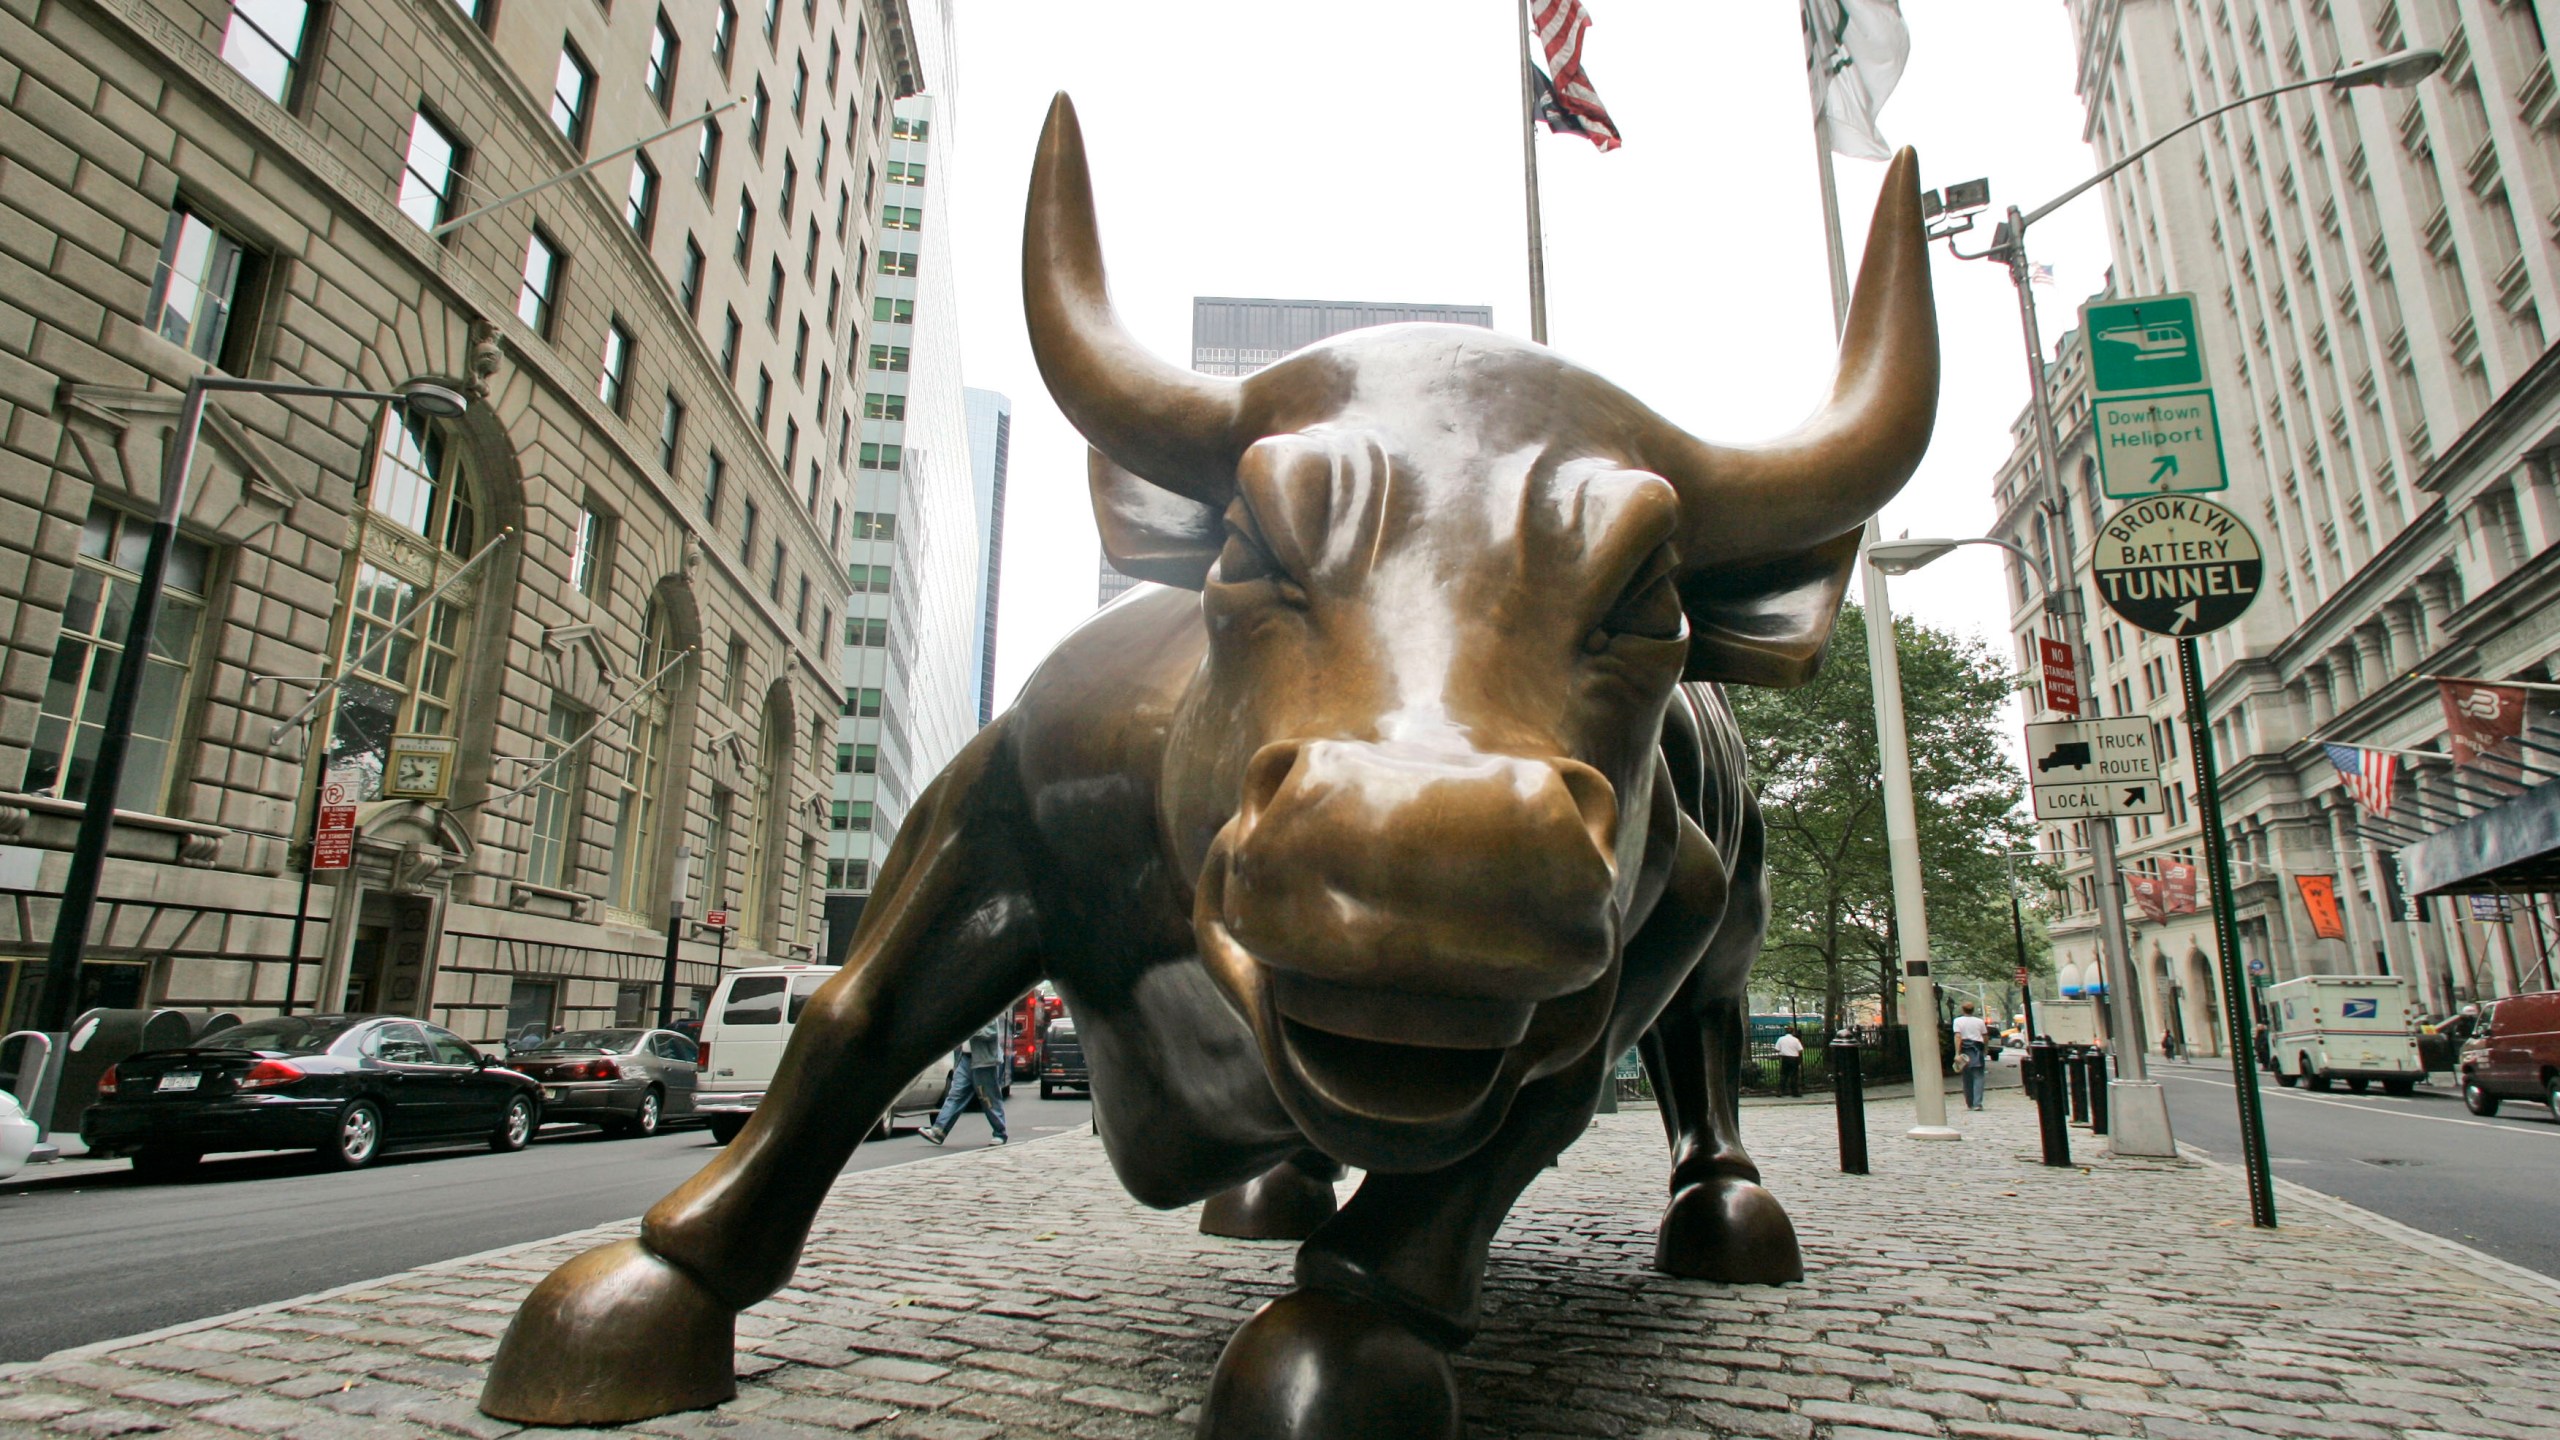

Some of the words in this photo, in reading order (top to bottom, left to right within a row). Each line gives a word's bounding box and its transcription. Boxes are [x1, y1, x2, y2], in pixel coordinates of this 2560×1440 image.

[2108, 407, 2200, 425] Downtown
[2112, 426, 2203, 448] Heliport
[2108, 500, 2236, 543] BROOKLYN
[2121, 539, 2229, 565] BATTERY
[2102, 565, 2254, 601] TUNNEL
[2051, 647, 2064, 663] NO
[2044, 664, 2075, 681] STANDING
[2048, 681, 2076, 696] ANYTIME
[2096, 733, 2147, 749] TRUCK
[2100, 758, 2150, 774] ROUTE
[2048, 793, 2099, 809] LOCAL
